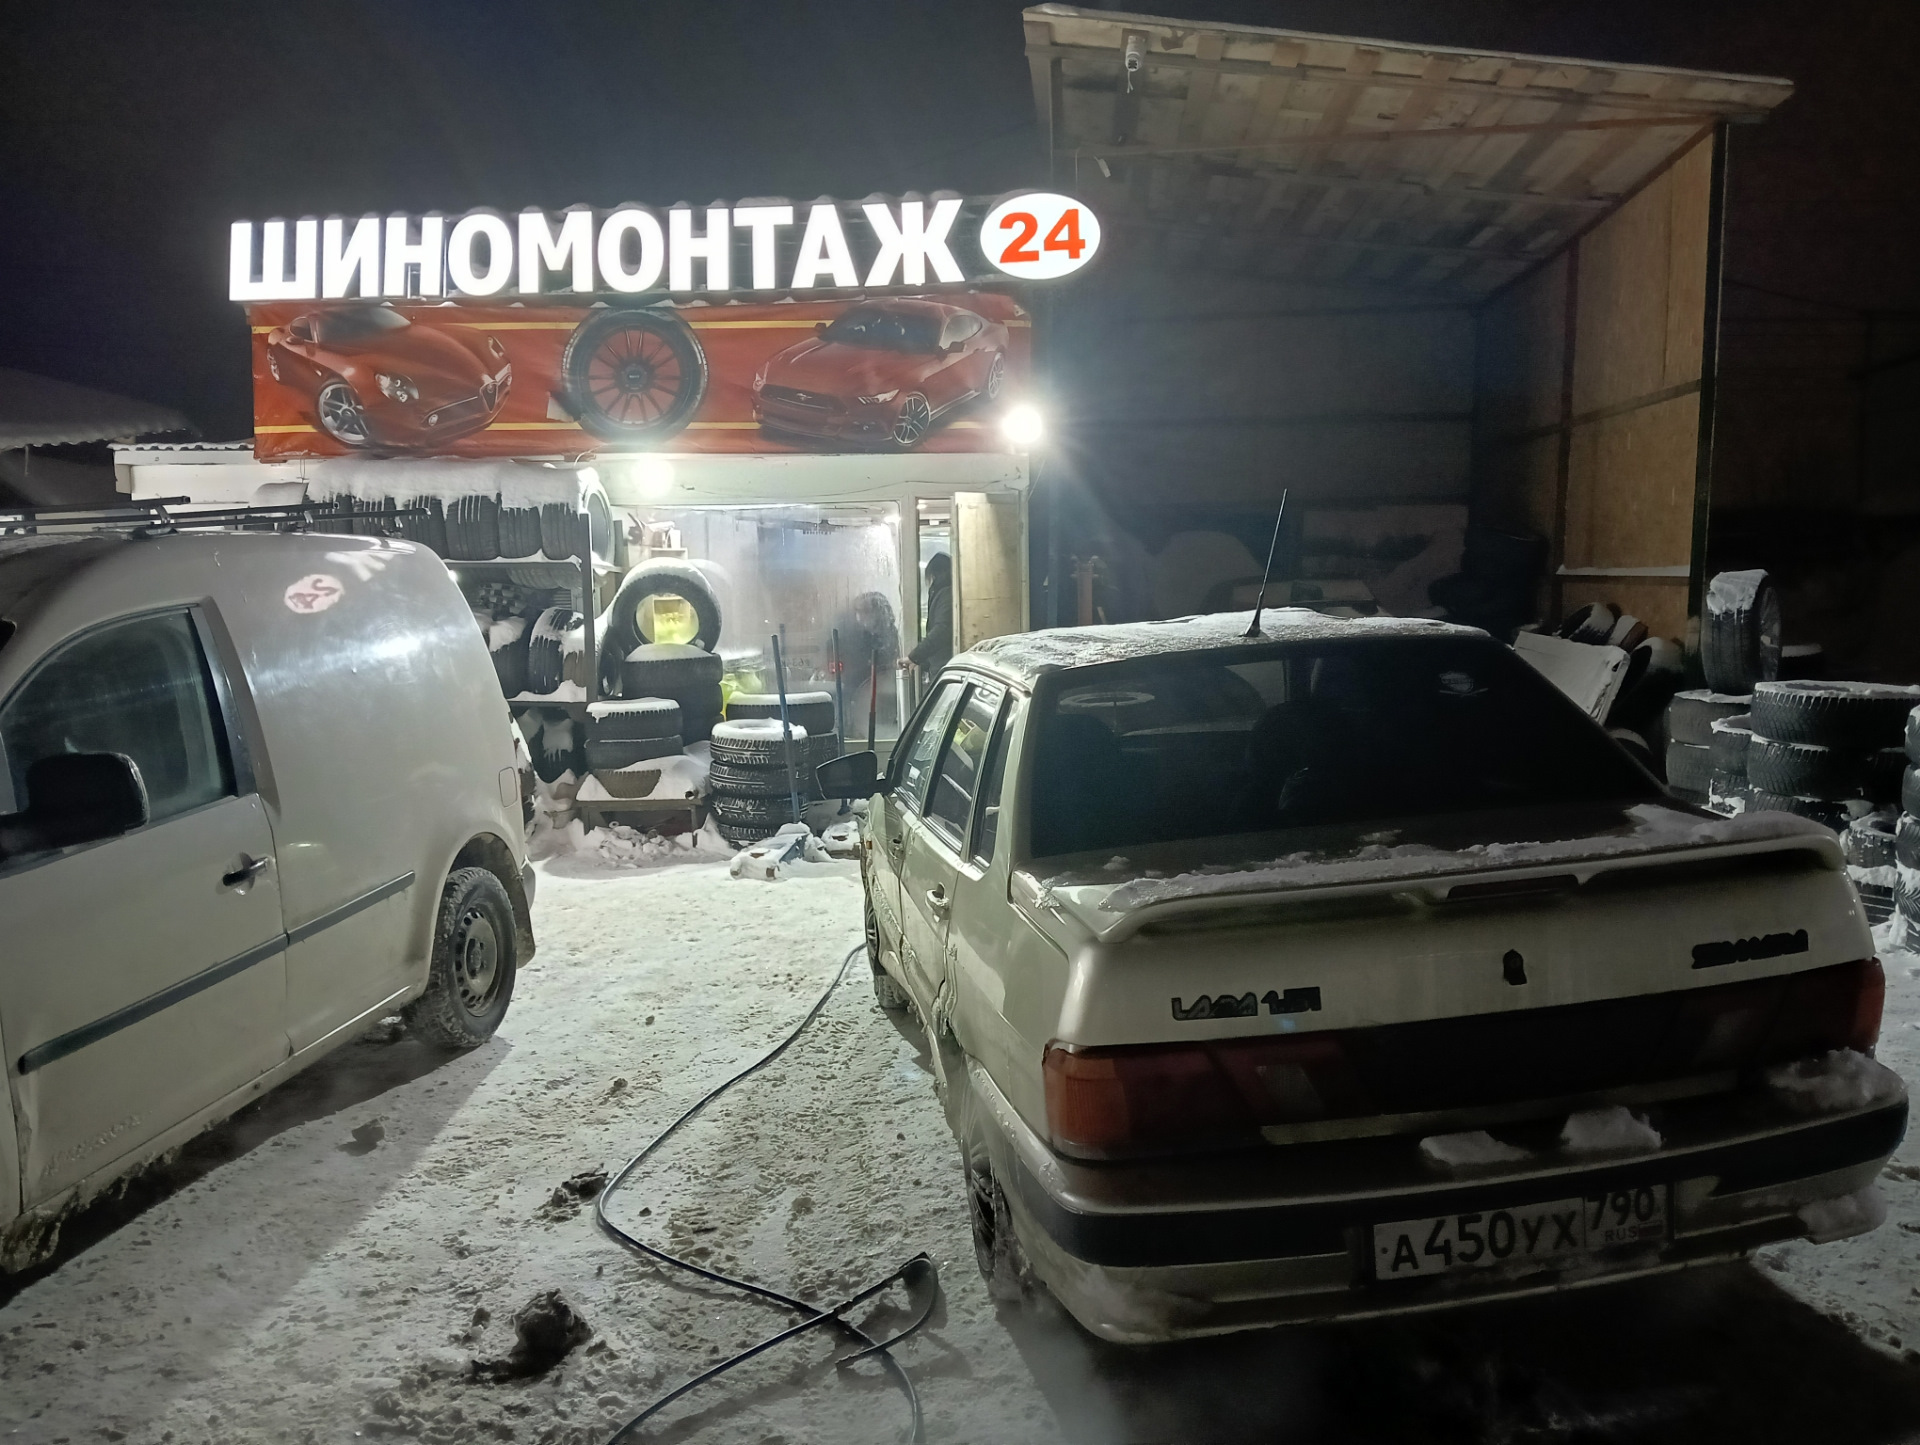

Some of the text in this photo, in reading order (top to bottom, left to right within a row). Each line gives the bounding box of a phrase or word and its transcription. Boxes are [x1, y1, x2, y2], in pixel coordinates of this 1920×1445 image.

[228, 197, 1087, 303] ШИНОМОНТАЖ 24
[1587, 1186, 1654, 1230] 790
[1604, 1225, 1638, 1242] RUS
